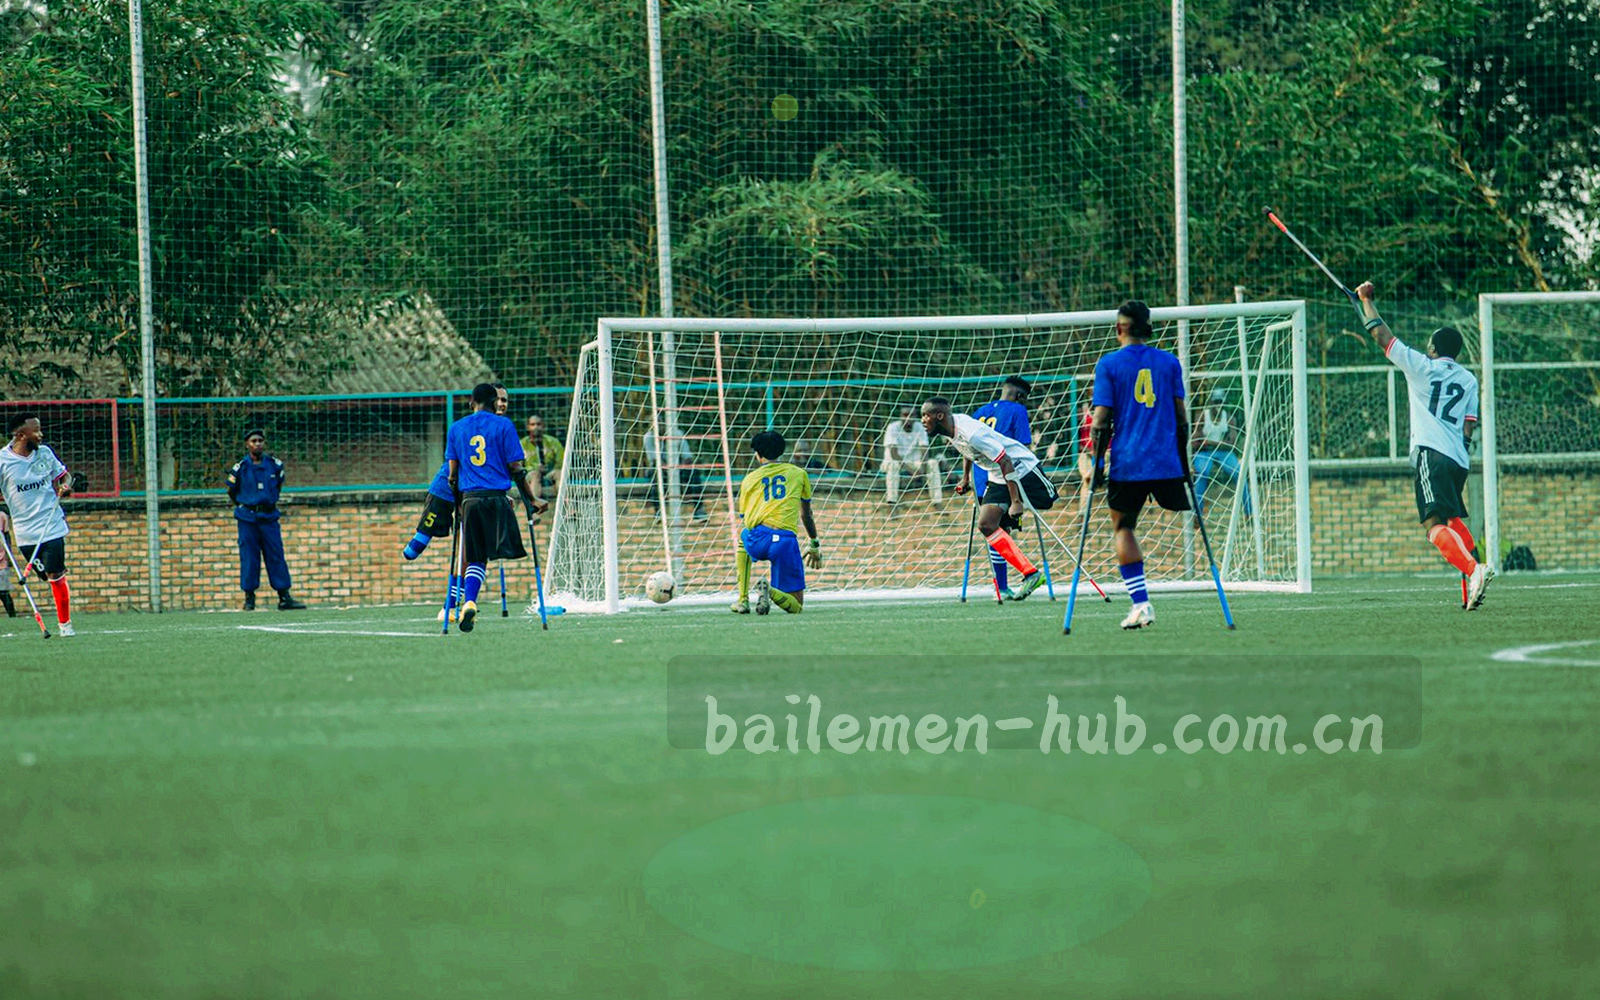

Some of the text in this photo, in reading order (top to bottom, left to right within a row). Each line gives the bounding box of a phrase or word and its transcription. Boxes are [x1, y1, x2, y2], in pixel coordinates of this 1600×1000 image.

[1134, 368, 1157, 408] 4
[1428, 380, 1466, 425] 12
[469, 434, 487, 467] 3
[761, 474, 787, 502] 16
[424, 512, 437, 528] 5
[33, 558, 45, 571] 8
